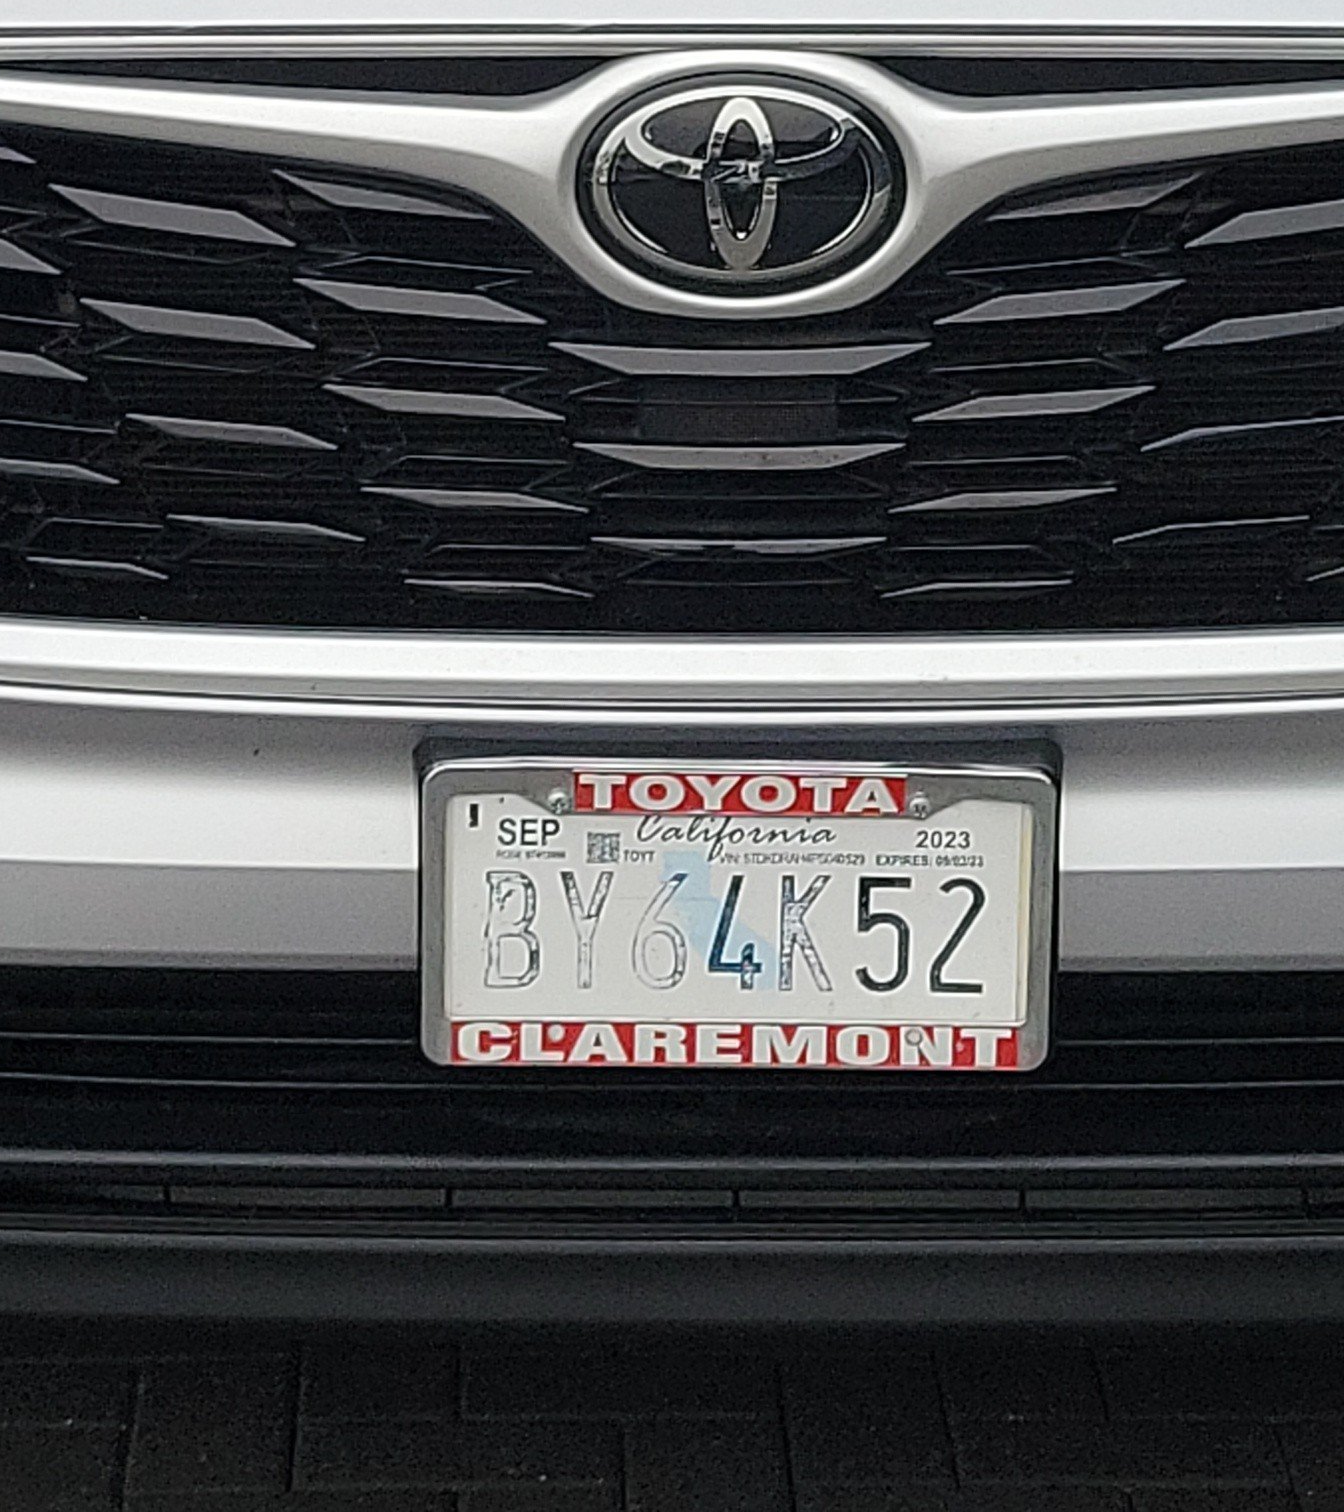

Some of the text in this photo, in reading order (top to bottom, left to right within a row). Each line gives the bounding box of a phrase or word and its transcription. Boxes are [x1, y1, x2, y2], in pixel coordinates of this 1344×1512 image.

[577, 774, 902, 814] TOYOTA
[498, 818, 560, 846] SEP
[637, 814, 837, 862] California
[915, 830, 972, 849] 2023
[485, 870, 987, 995] BY64K52
[457, 1023, 1016, 1067] CLAREMONT
